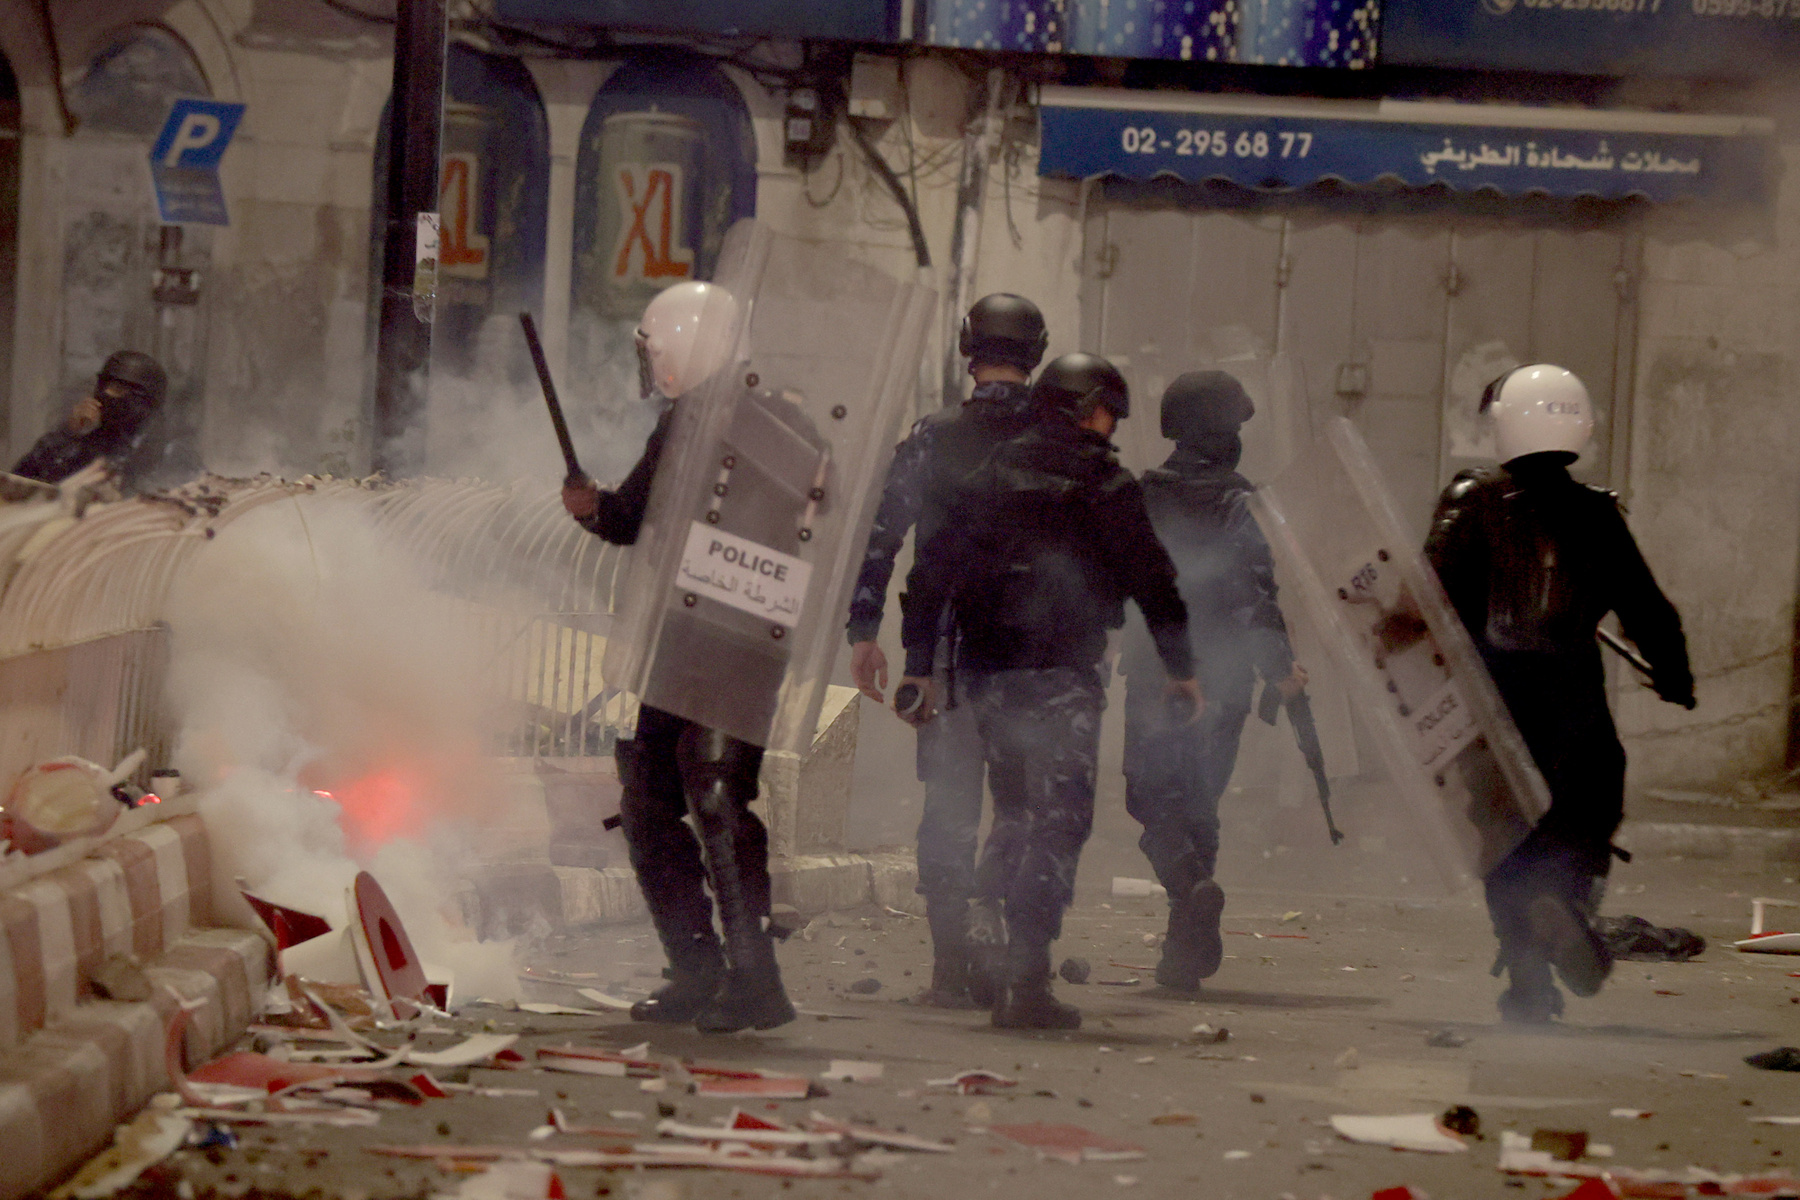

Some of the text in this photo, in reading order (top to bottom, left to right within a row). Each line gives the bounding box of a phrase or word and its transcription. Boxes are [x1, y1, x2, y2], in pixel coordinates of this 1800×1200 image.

[165, 113, 221, 168] P
[1526, 140, 1615, 172] شحادة
[1620, 151, 1699, 173] محلات
[615, 169, 690, 278] XL
[682, 558, 800, 614] الشرطة الخاصة
[708, 540, 789, 583] POLICE
